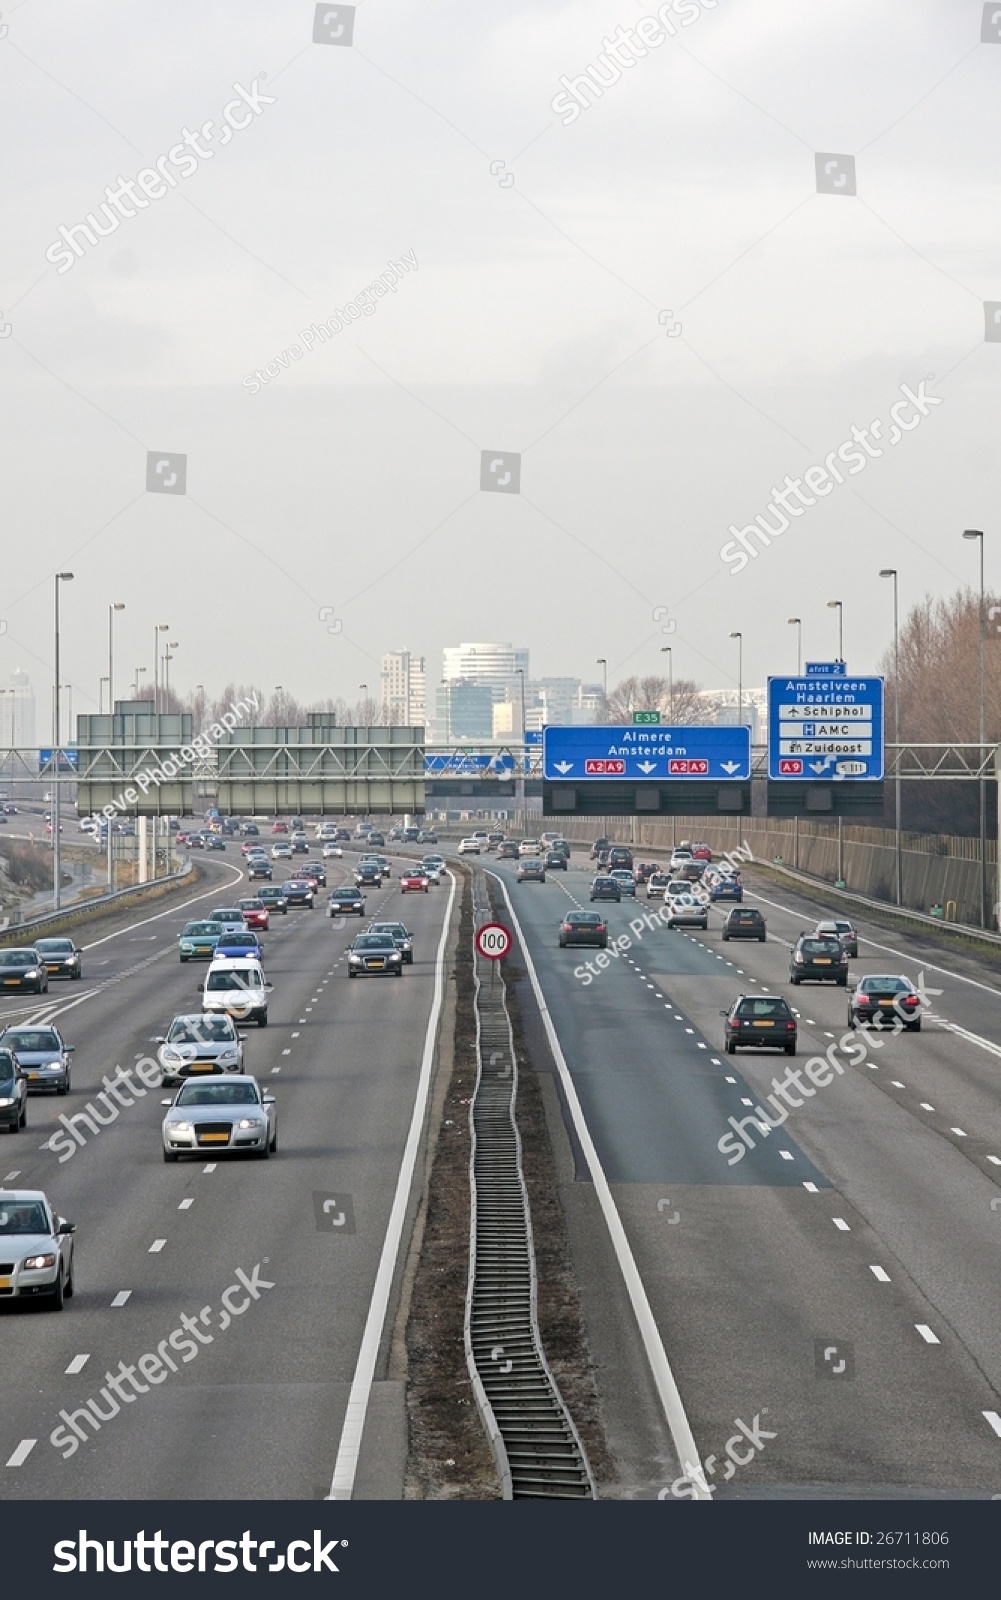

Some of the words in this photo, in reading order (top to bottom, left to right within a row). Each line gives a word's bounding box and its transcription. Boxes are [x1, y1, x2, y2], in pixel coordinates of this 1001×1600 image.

[833, 665, 840, 674] 2
[785, 681, 867, 691] Amstelveen
[796, 693, 855, 703] Haarlem
[803, 706, 864, 717] Schiphol
[818, 725, 849, 735] AMC
[623, 731, 672, 742] Almere
[608, 745, 687, 756] Amsterdam
[805, 743, 862, 753] Zuidoost
[587, 762, 603, 772] A2
[605, 762, 624, 772] A9
[671, 762, 687, 772] A2
[689, 762, 707, 772] A9
[782, 762, 800, 771] A9
[483, 934, 505, 949] 100
